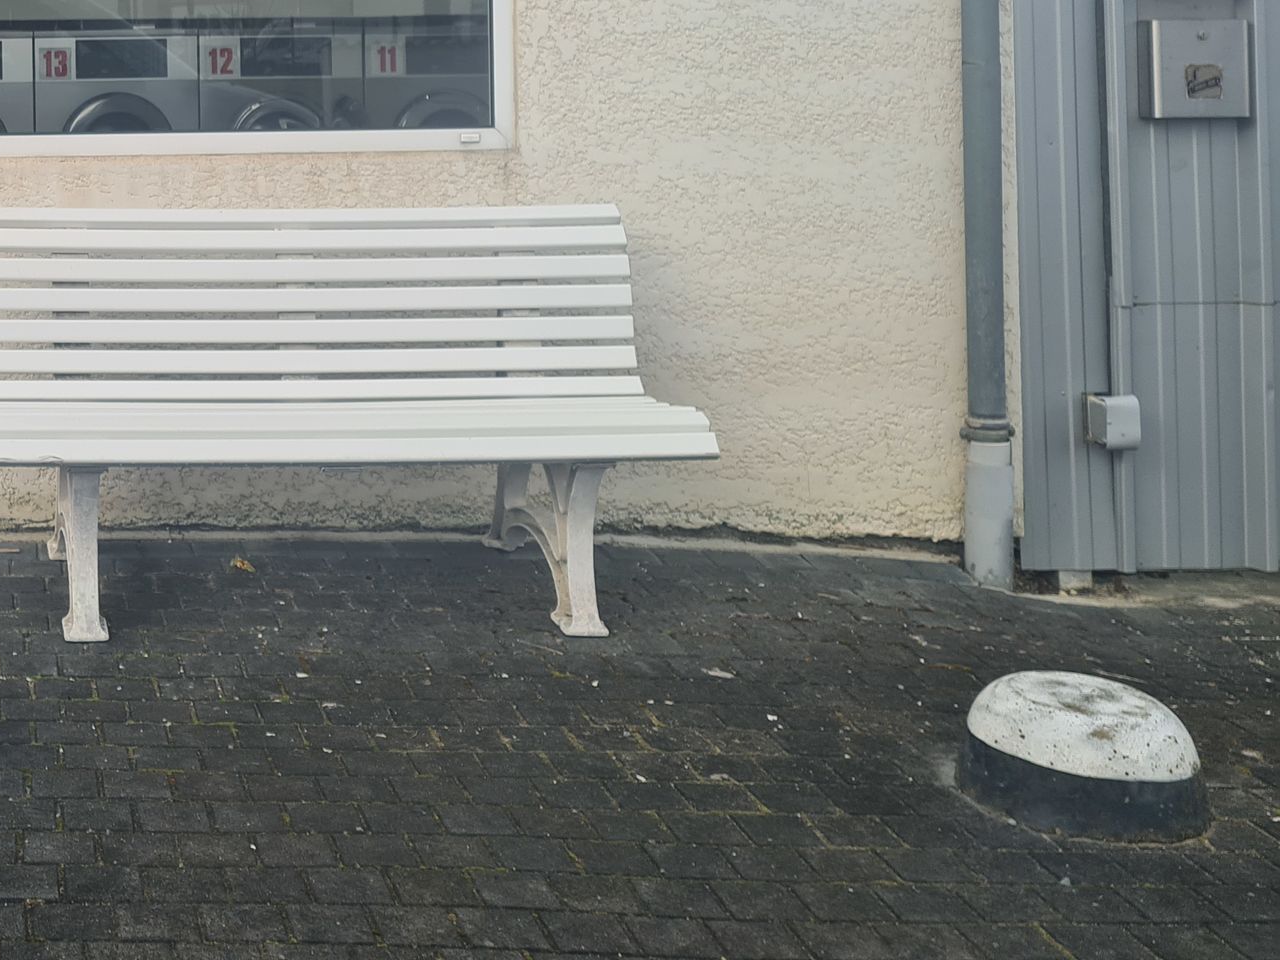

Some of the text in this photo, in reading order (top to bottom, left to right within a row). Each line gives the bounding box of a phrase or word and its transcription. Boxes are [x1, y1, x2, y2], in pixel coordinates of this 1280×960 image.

[44, 50, 68, 77] 13
[209, 48, 234, 75] 12
[377, 46, 397, 72] 11
